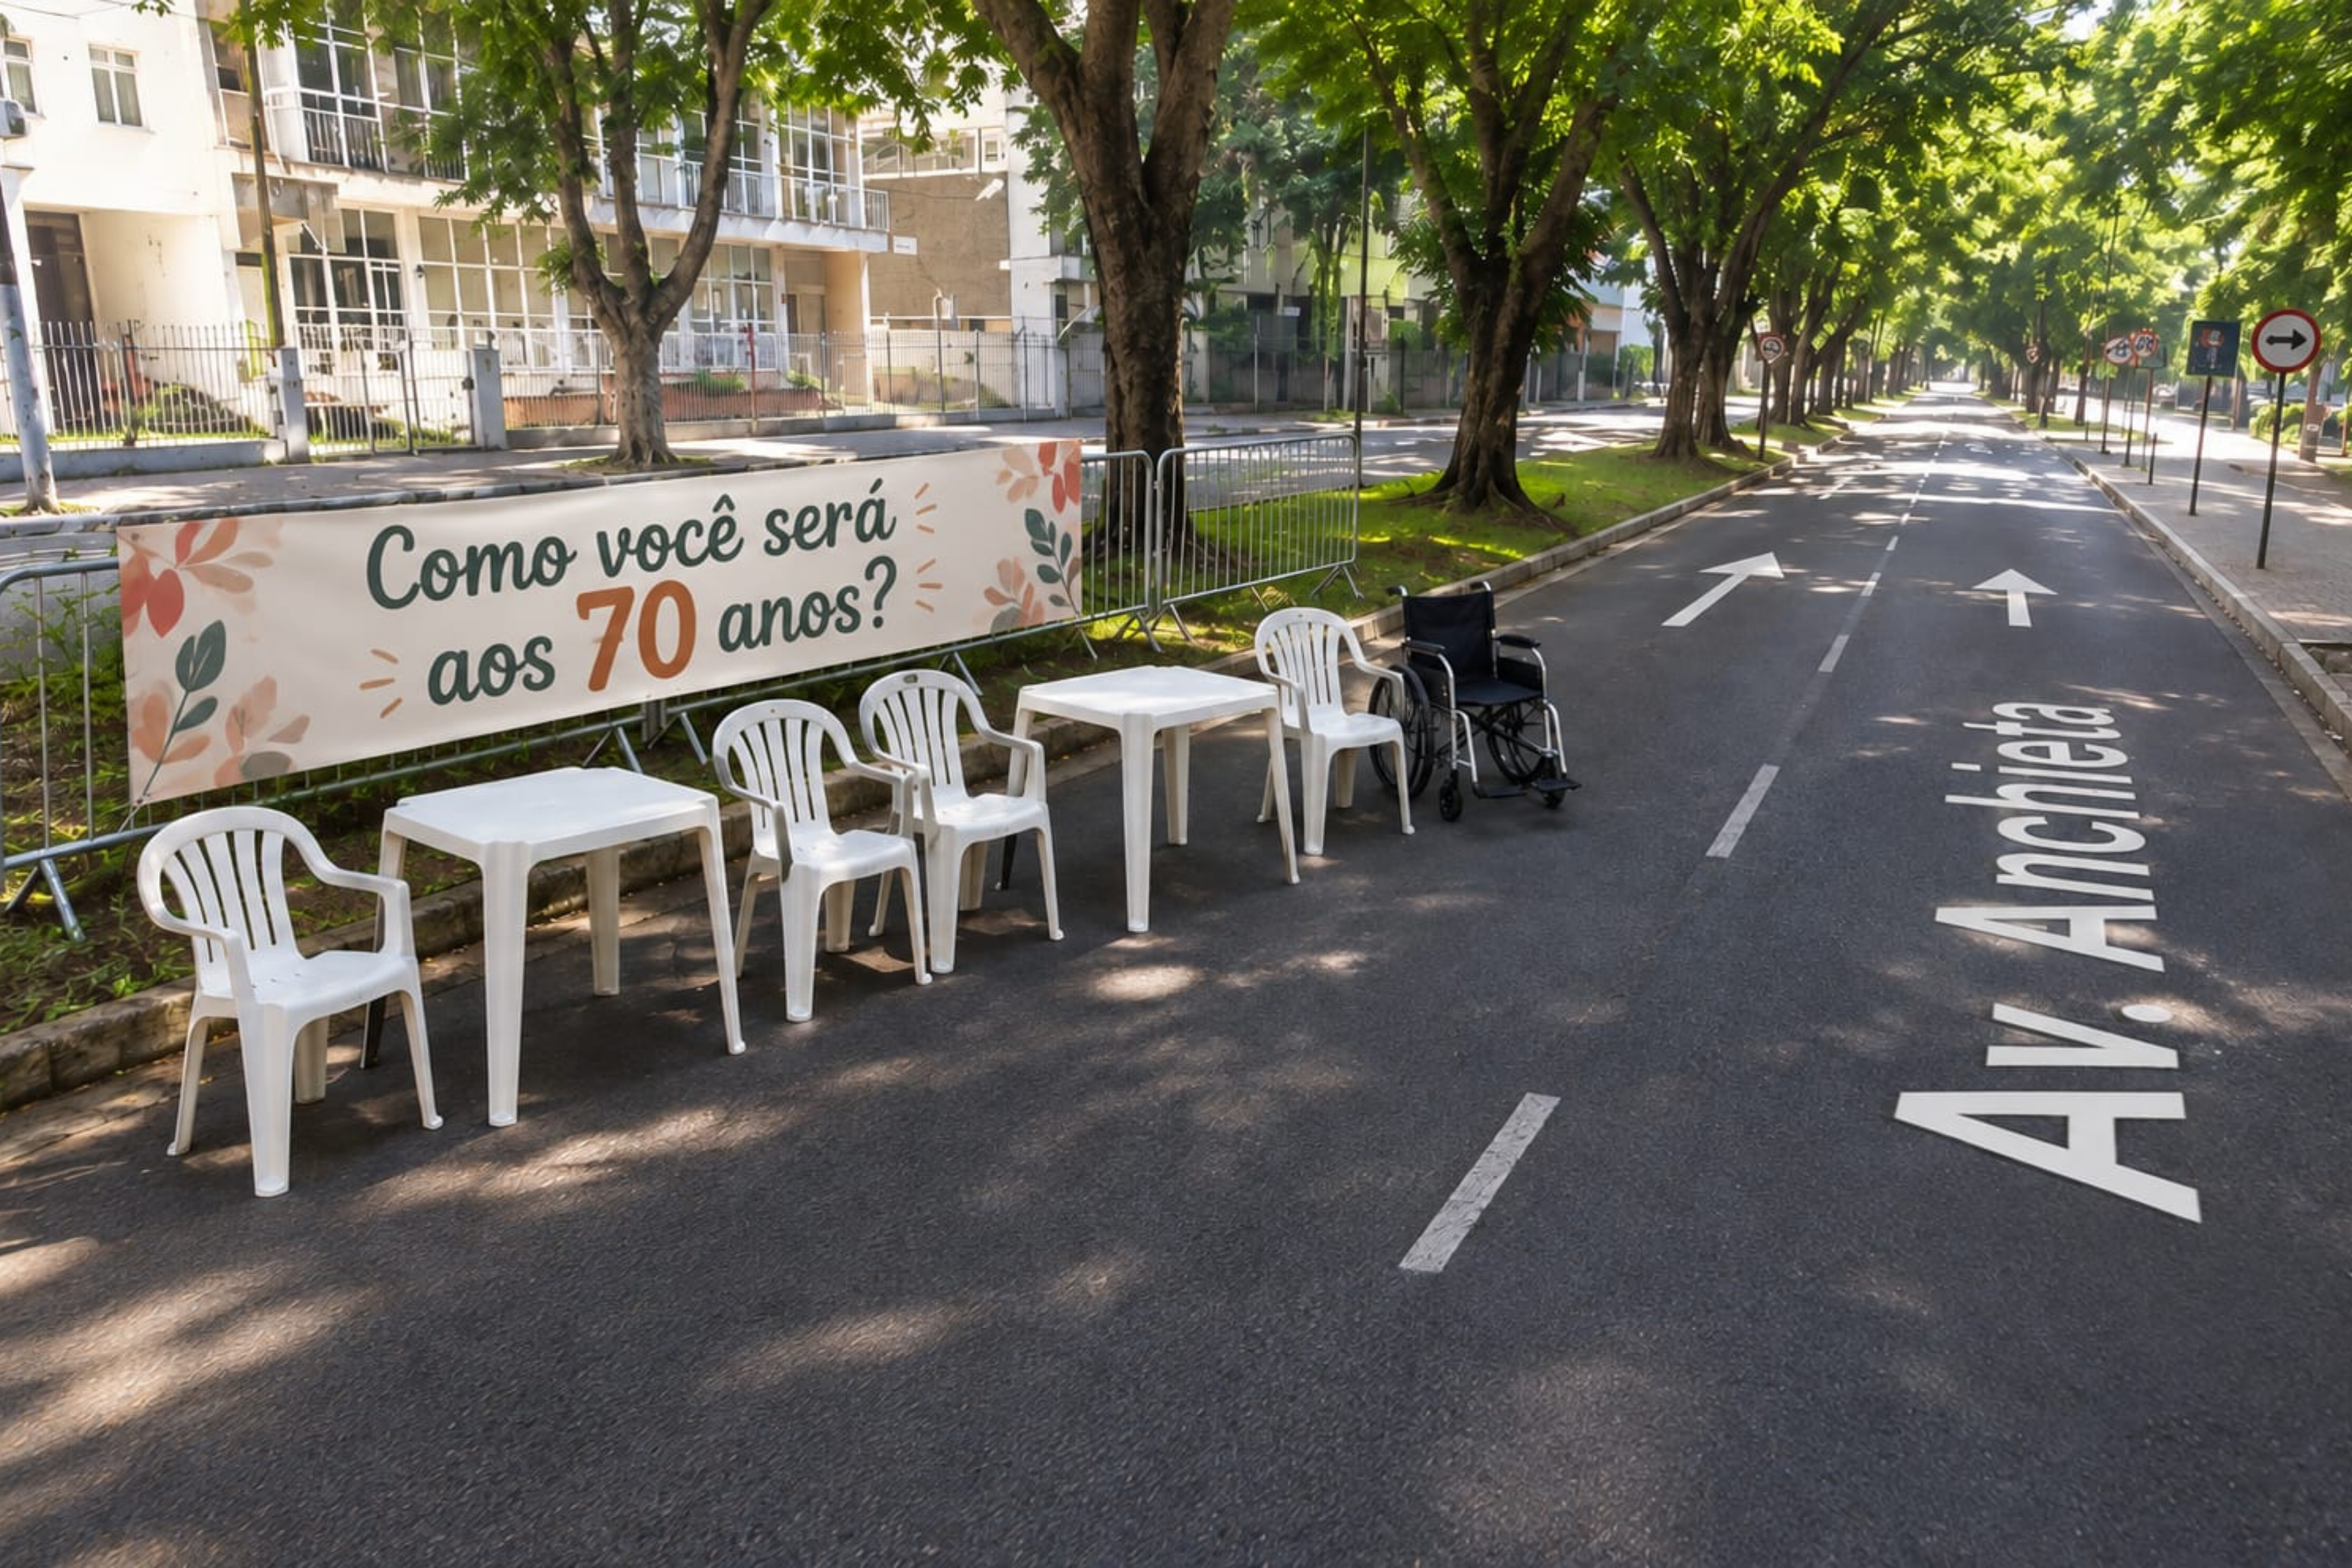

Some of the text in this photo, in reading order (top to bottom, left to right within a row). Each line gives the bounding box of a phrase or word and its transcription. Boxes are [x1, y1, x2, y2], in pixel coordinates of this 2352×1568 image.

[367, 479, 896, 609] Como você será
[428, 556, 897, 705] aos 70 anos?
[1894, 703, 2201, 1223] Av. Anchieta
